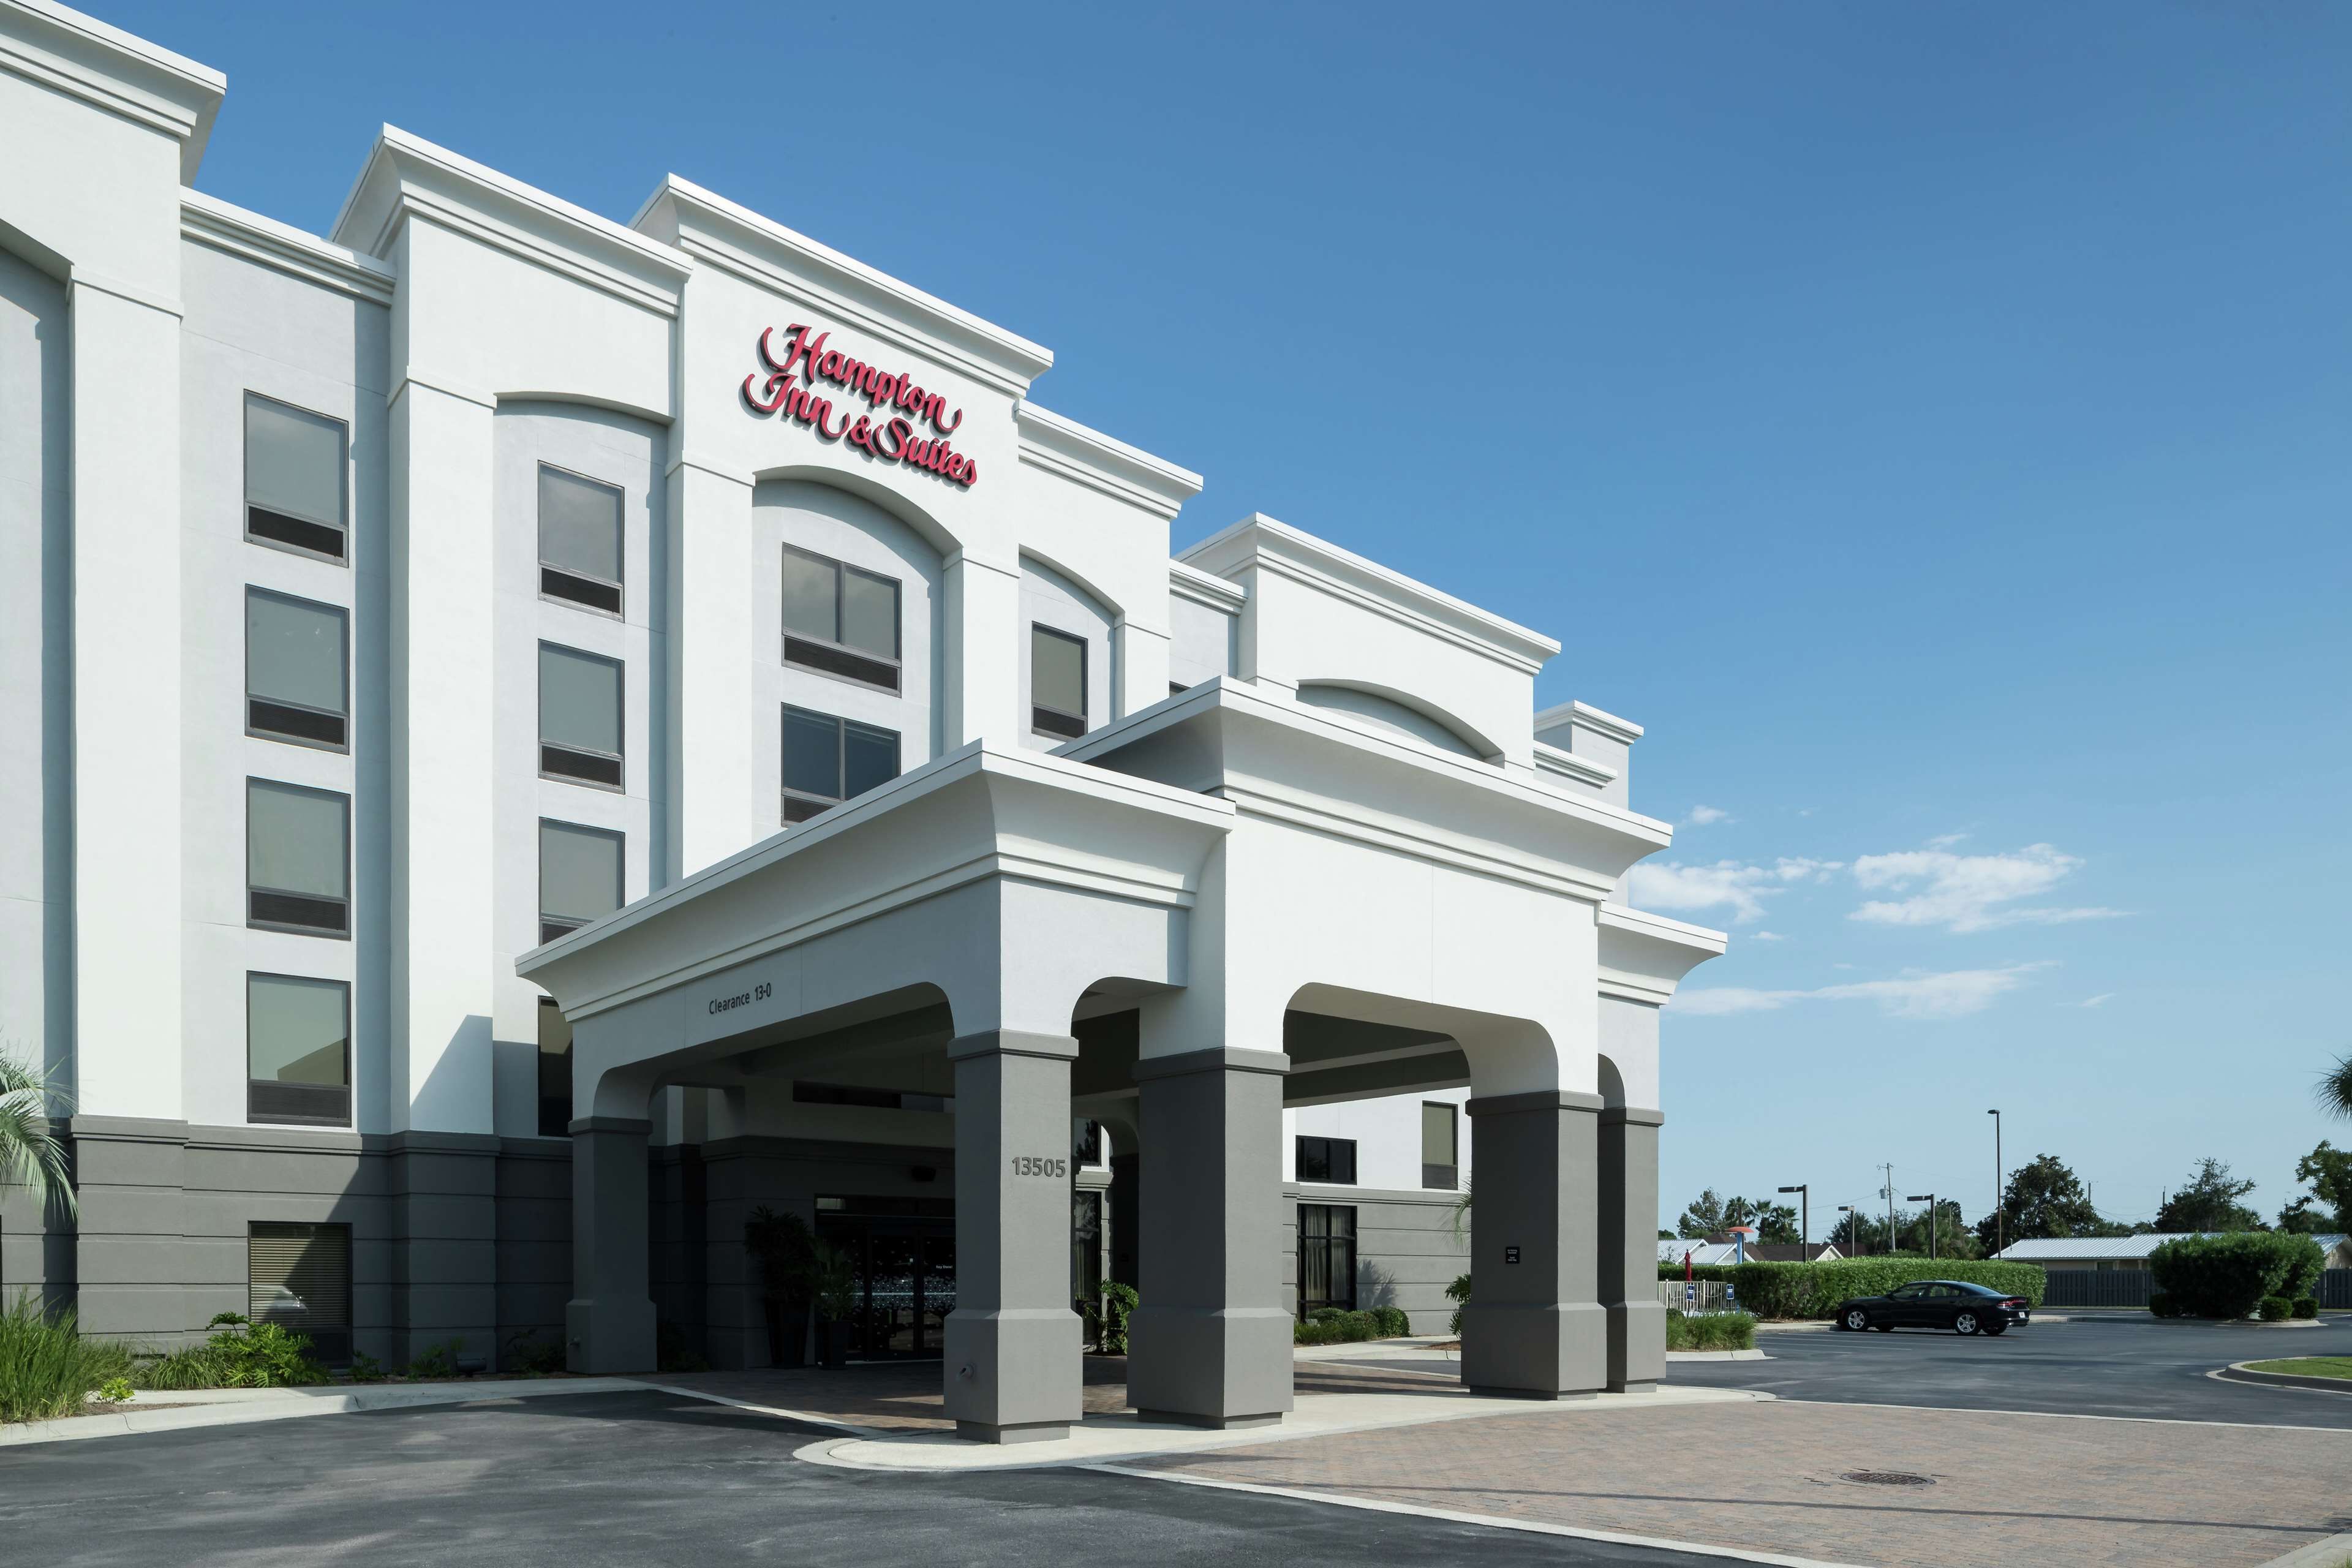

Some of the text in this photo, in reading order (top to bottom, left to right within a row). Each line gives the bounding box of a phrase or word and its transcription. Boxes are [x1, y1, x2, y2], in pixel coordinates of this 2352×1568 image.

[759, 323, 962, 433] Hampton
[742, 373, 850, 439] Inn
[872, 417, 977, 487] Suites
[709, 982, 771, 1014] Clearance 13-0
[1012, 1156, 1066, 1177] 13505
